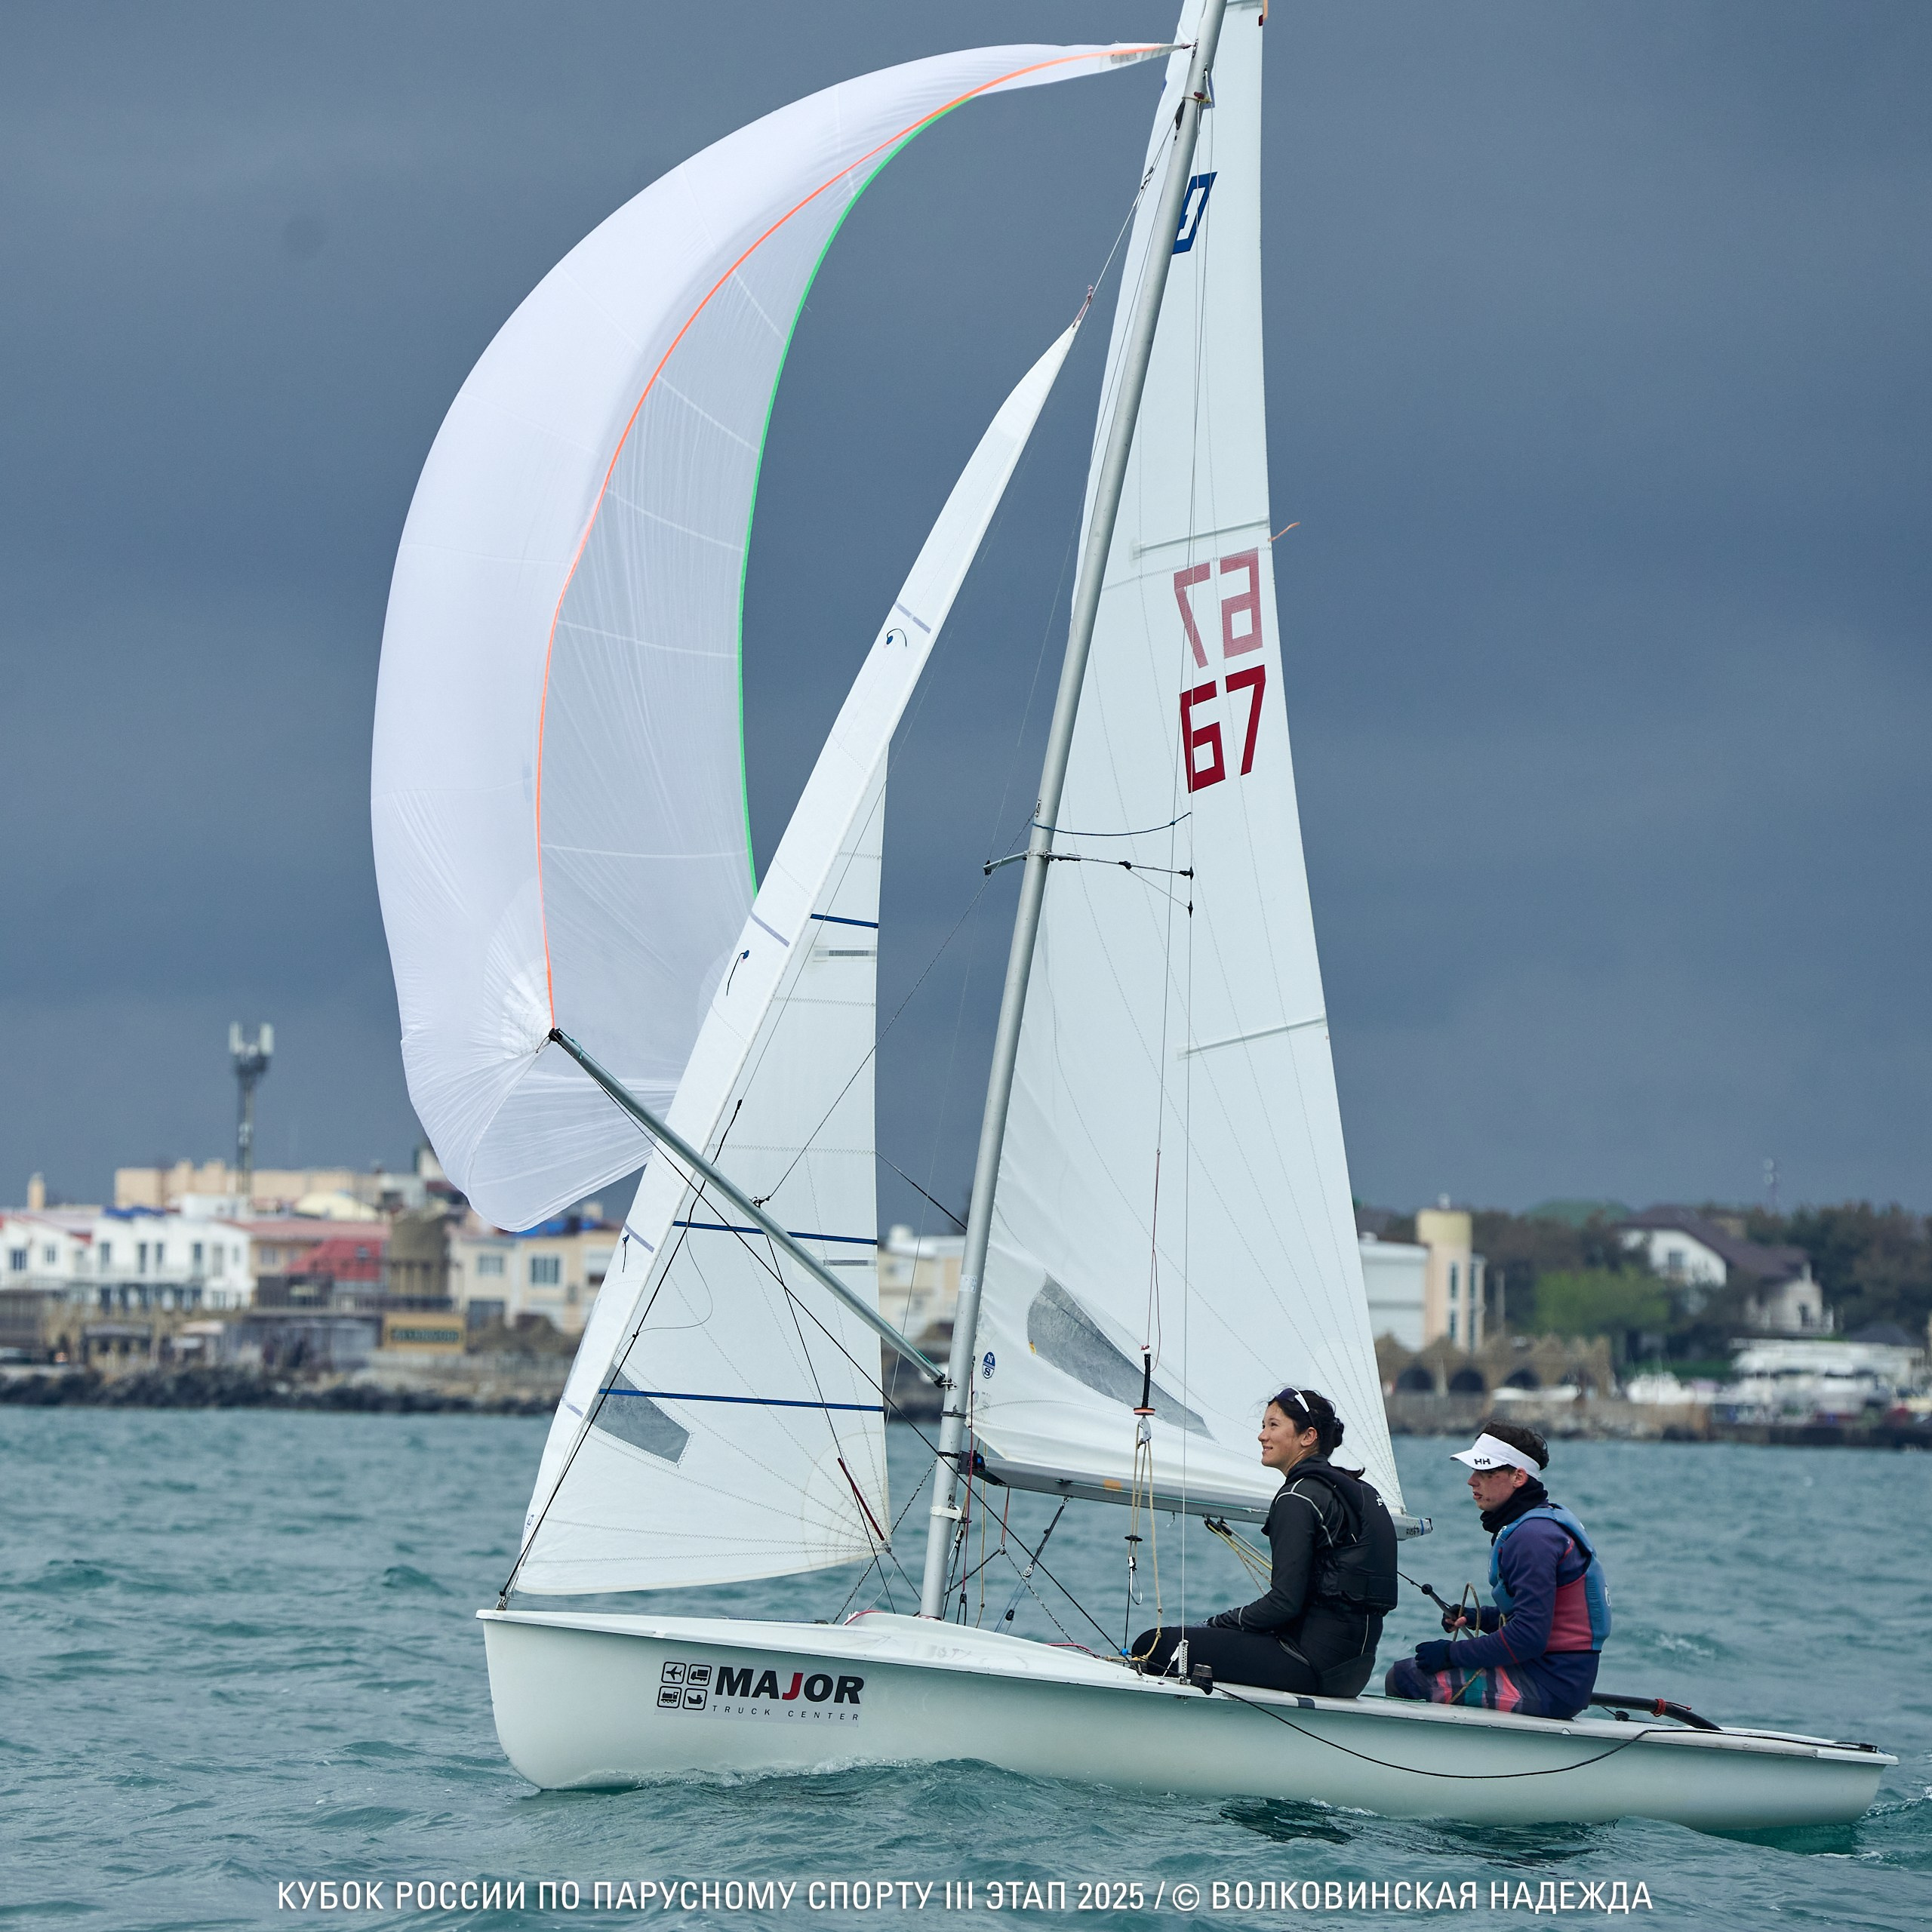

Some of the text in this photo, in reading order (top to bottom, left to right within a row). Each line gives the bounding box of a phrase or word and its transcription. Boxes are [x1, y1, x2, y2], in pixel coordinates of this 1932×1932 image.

[1179, 664, 1266, 794] 67
[715, 1666, 865, 1705] MAJOR
[712, 1705, 858, 1721] TRUCK CENTER
